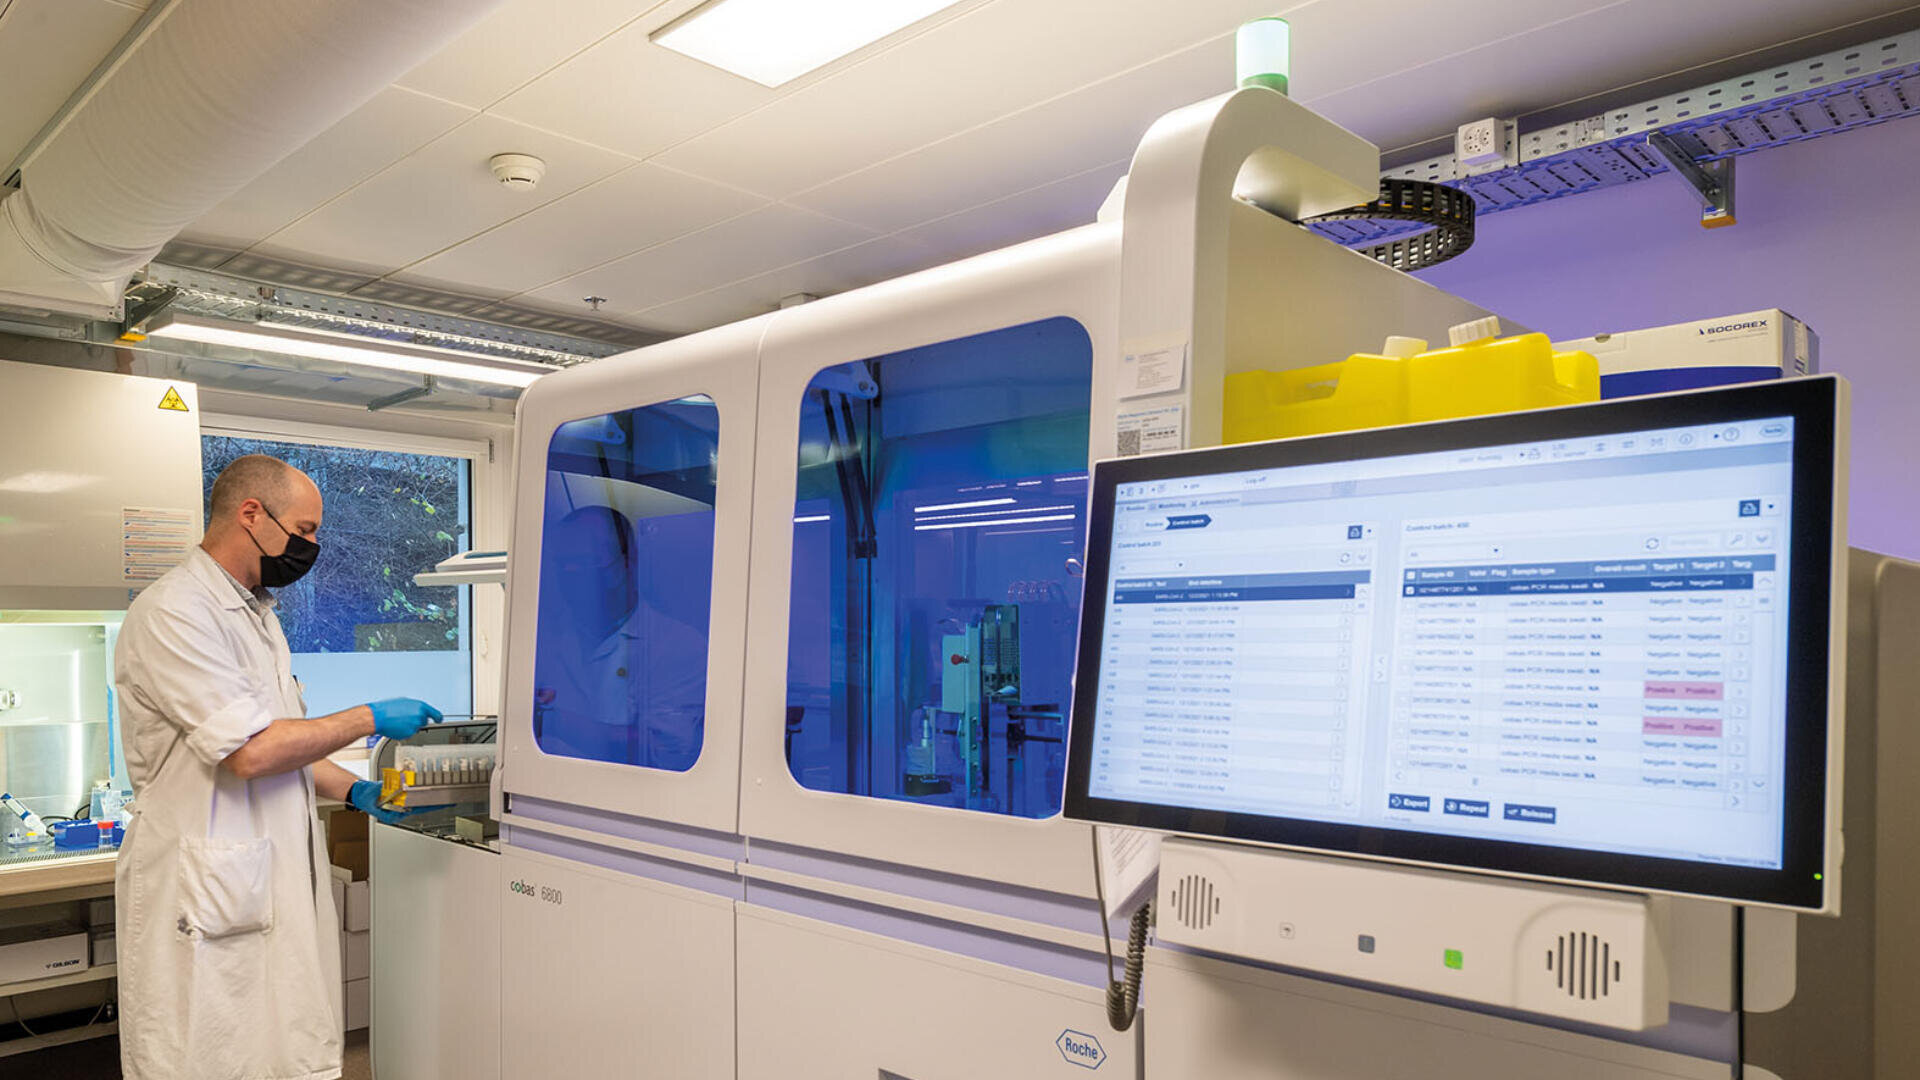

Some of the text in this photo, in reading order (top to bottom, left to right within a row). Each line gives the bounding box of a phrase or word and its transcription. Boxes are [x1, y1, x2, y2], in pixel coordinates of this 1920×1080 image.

[1707, 319, 1767, 334] SOCOREX
[1652, 562, 1678, 572] Target
[1691, 561, 1717, 570] Target
[1403, 798, 1428, 809] Export
[1459, 803, 1488, 814] Repeat
[510, 879, 562, 905] cobas 6800
[1065, 1037, 1098, 1060] Roche
